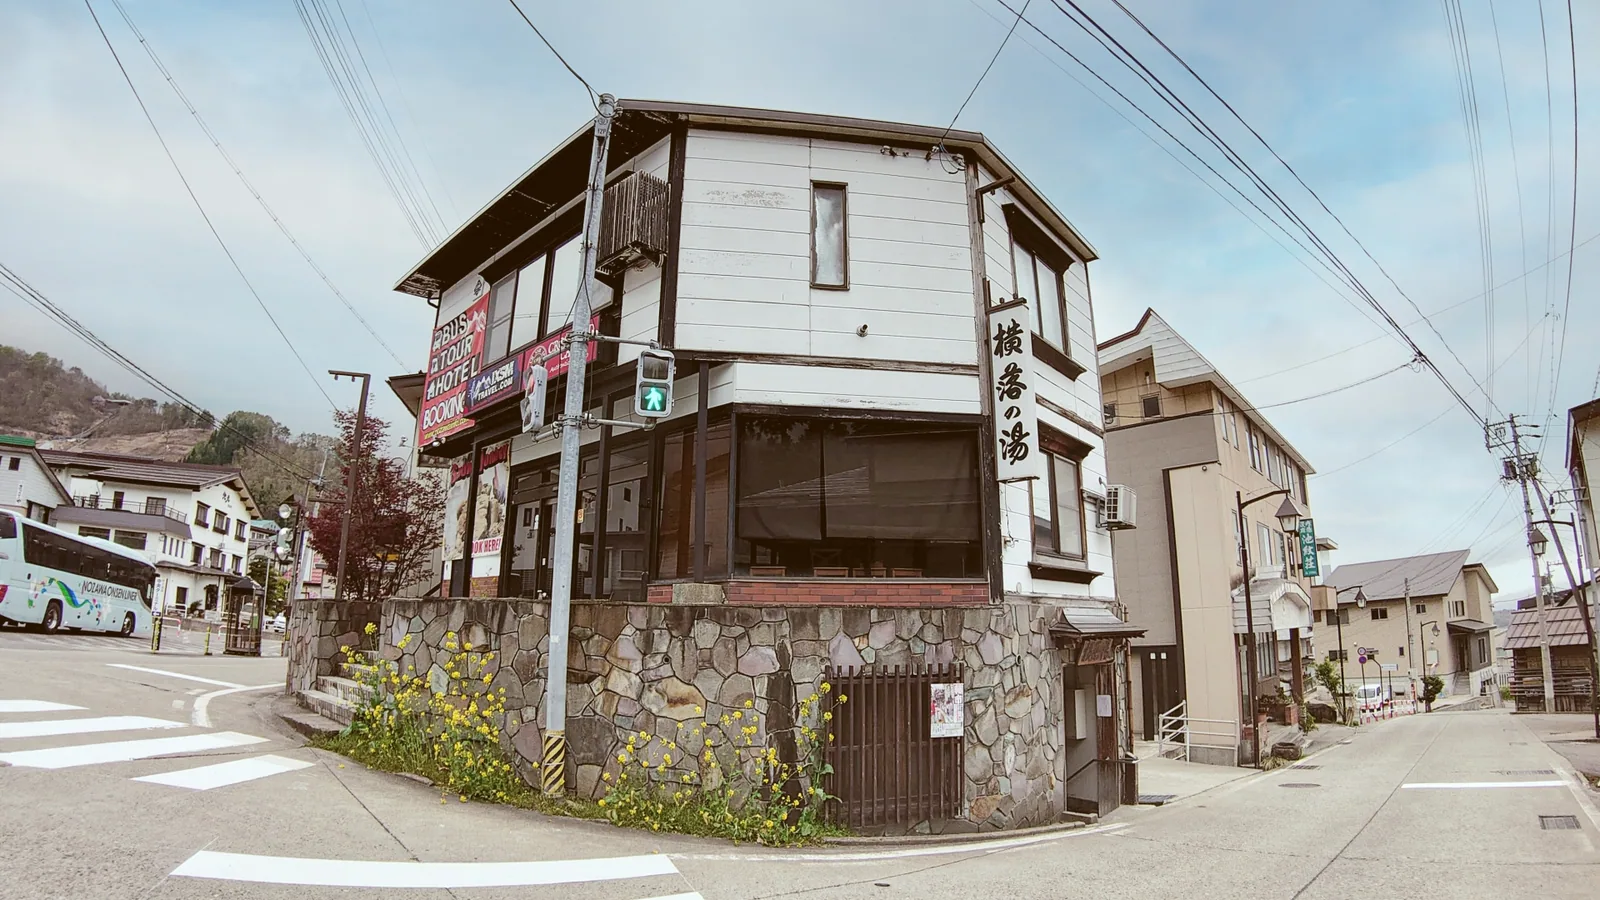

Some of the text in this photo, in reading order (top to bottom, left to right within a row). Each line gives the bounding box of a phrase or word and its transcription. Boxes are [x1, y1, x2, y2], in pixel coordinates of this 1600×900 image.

[441, 313, 469, 348] BUS
[440, 334, 473, 369] TOUR
[435, 356, 478, 396] HOTEL
[478, 376, 514, 400] TRAVEL.COM
[993, 319, 1030, 465] 横落の湯
[82, 581, 138, 600] NOZAWA ONSEN LINER
